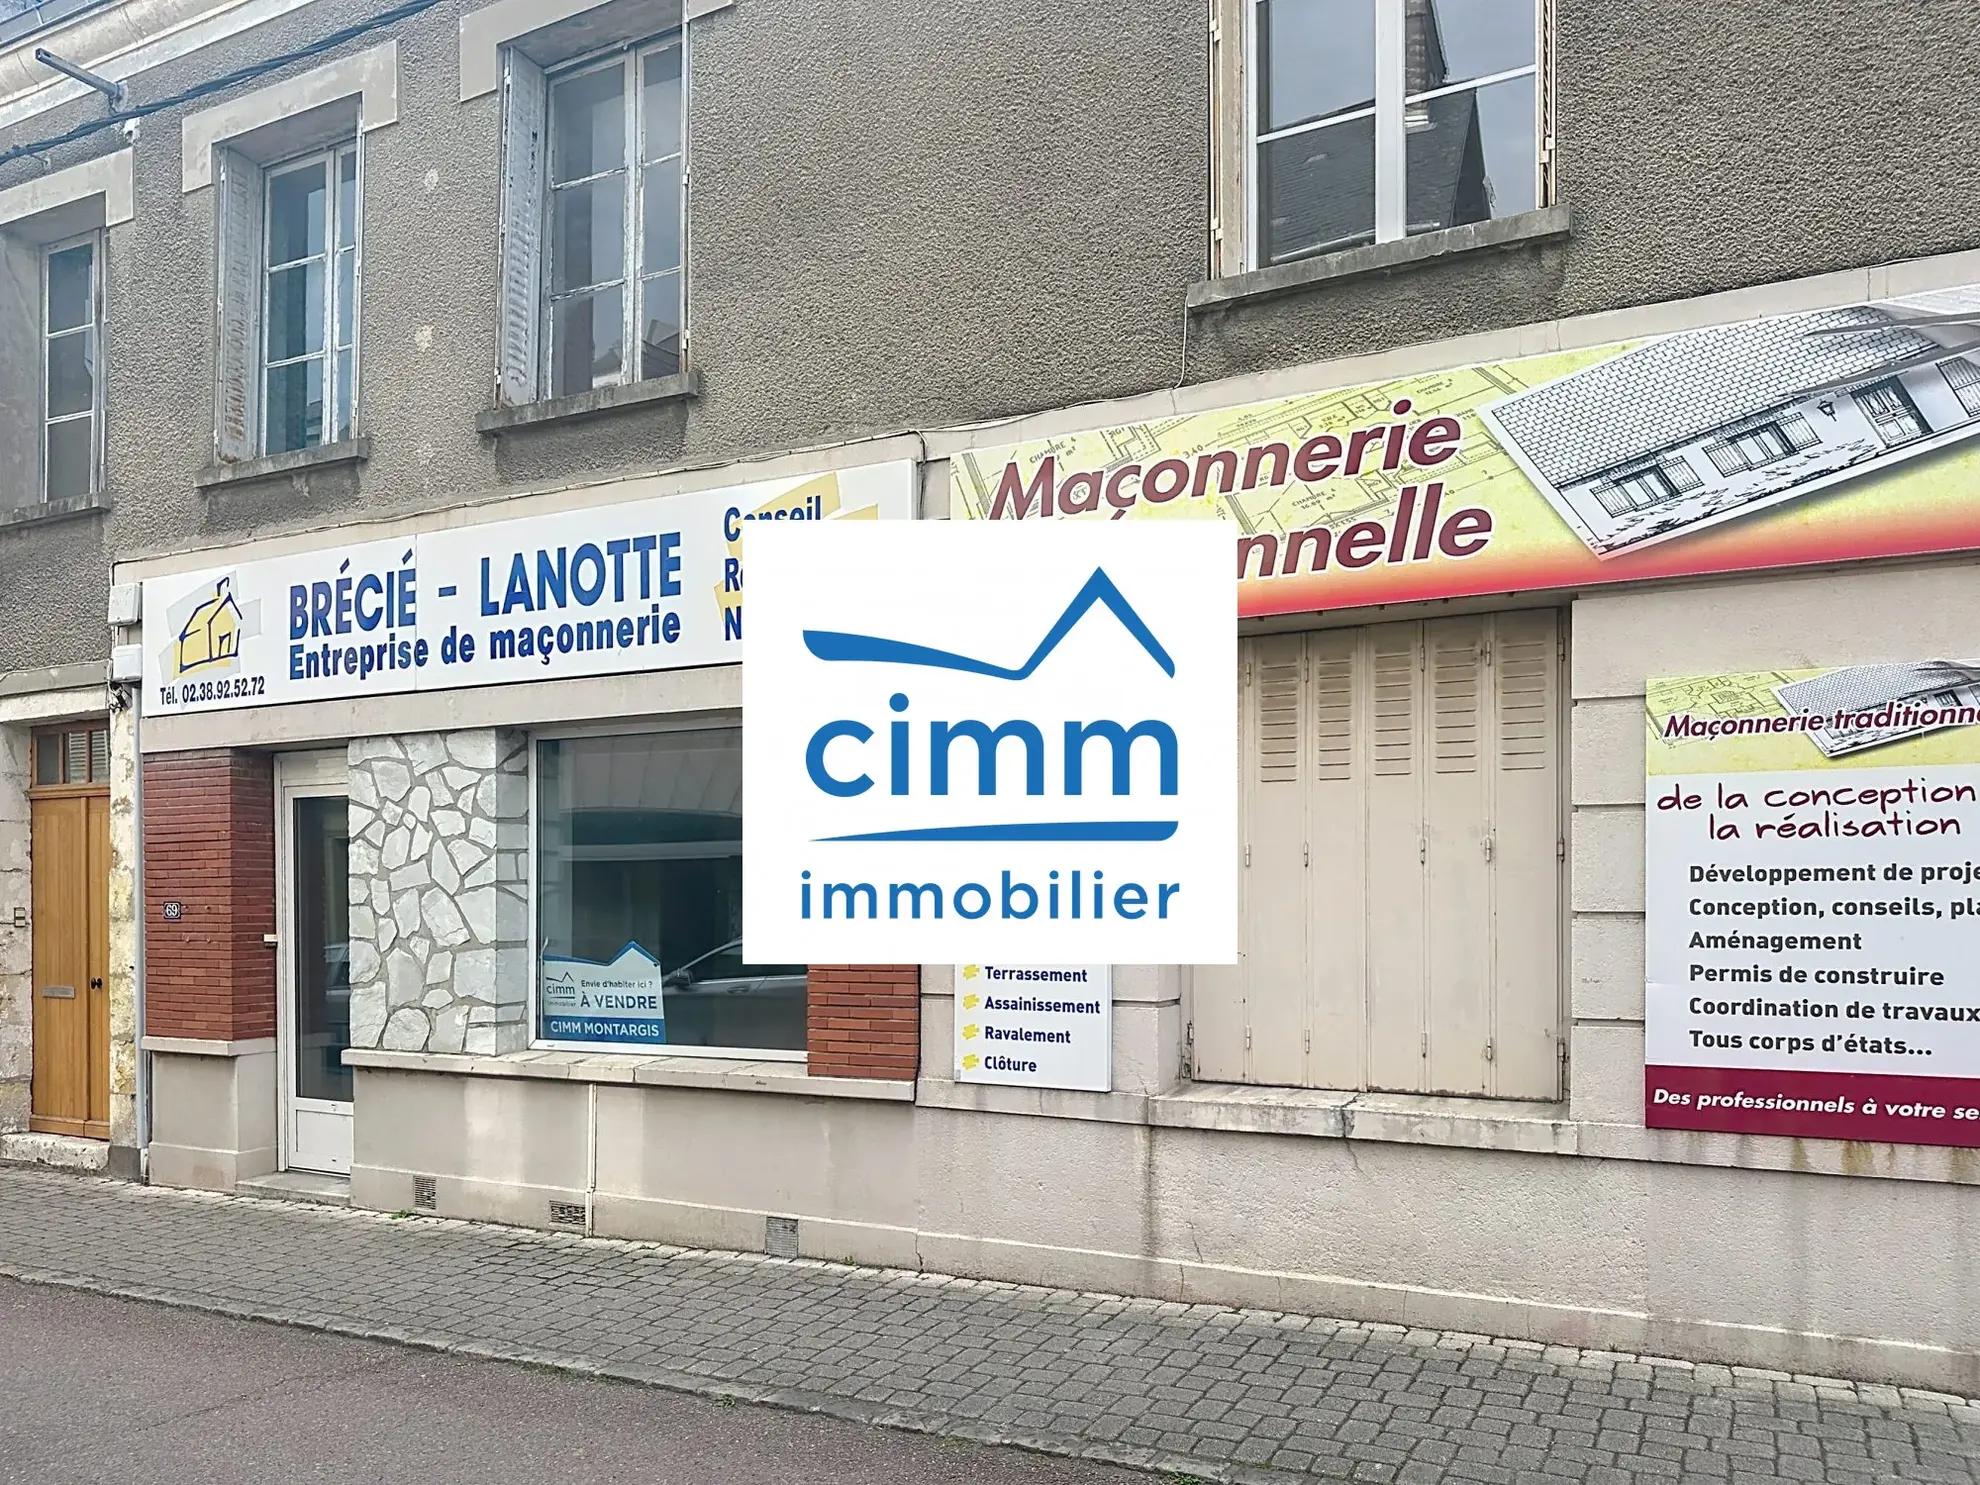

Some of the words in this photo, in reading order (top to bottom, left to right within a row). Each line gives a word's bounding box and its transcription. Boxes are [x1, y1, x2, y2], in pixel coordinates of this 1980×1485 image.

[989, 399, 1461, 521] Maçonnerie
[290, 548, 416, 640] BRÉCIÉ
[438, 586, 457, 597] -
[481, 532, 681, 617] LANOTTE
[290, 633, 429, 680] Entreprise
[441, 626, 475, 664] de
[490, 604, 681, 665] maçonnerie
[160, 686, 178, 705] Tél.
[182, 676, 265, 703] 02.38.92.52.72
[1664, 709, 1824, 741] Maçonnerie
[1835, 701, 1980, 729] traditionn
[1657, 784, 1702, 811] de
[1718, 783, 1748, 809] la
[1764, 778, 1977, 814] conception
[1709, 814, 1740, 840] la
[1755, 811, 1961, 839] réalisation
[1690, 864, 1876, 885] Développement
[1883, 862, 1913, 881] de
[166, 904, 178, 917] 69
[1690, 898, 1825, 919] Conception,
[1832, 897, 1942, 919] conseils,
[1689, 930, 1862, 952] Aménagement
[581, 980, 600, 988] Envie
[985, 966, 1088, 982] Terrassement
[1690, 964, 1772, 983] Permis
[1779, 966, 1807, 983] de
[1814, 967, 1945, 985] construire
[546, 983, 575, 995] cimm
[580, 991, 590, 1008] À
[594, 995, 657, 1009] VENDRE
[984, 996, 1101, 1014] Assainissement
[1689, 998, 1838, 1018] Coordination
[1846, 1001, 1875, 1019] de
[1883, 1003, 1980, 1022] travaux
[550, 1021, 582, 1034] CIMM
[584, 1022, 660, 1037] MONTARGIS
[985, 1026, 1071, 1043] Ravalement
[1689, 1030, 1742, 1048] Tous
[1749, 1035, 1815, 1054] corps
[984, 1056, 1037, 1072] Clôture
[1653, 1089, 1691, 1105] Des
[1697, 1091, 1855, 1114] professionnels
[1862, 1098, 1878, 1115] à
[1885, 1102, 1946, 1119] votre
[1953, 1107, 1980, 1120] se
